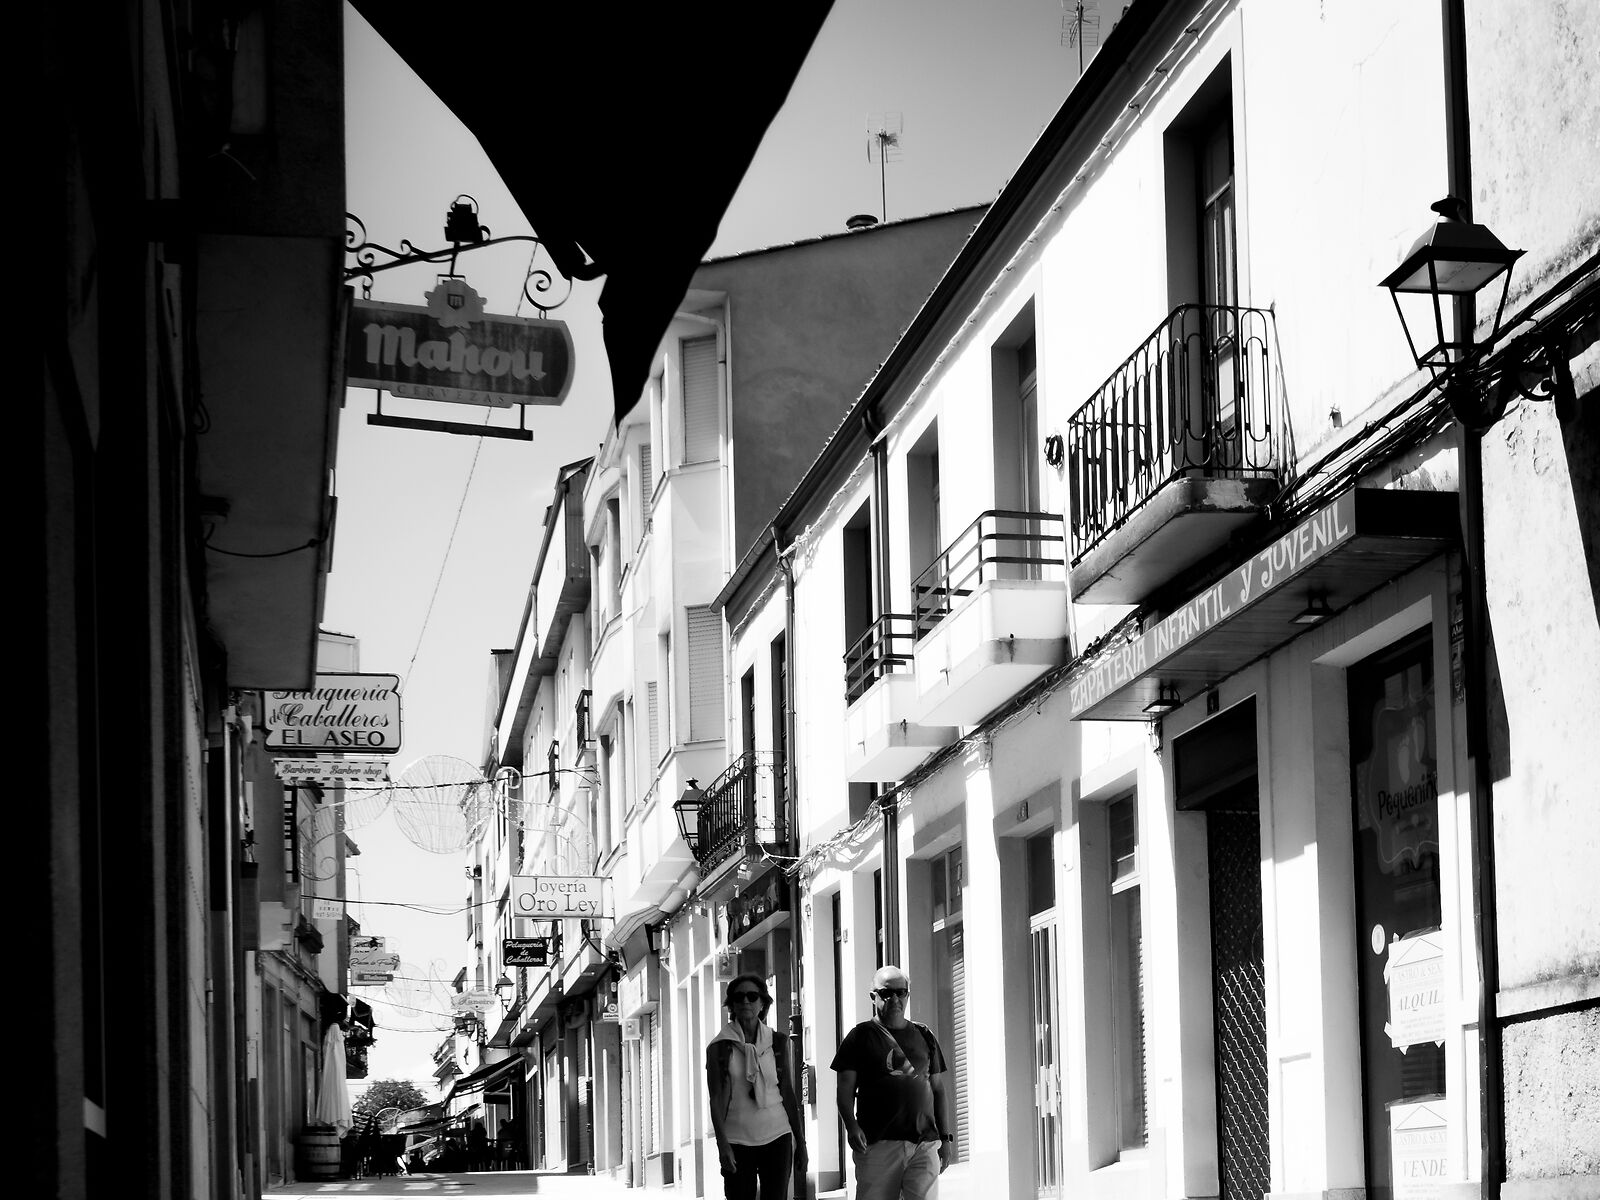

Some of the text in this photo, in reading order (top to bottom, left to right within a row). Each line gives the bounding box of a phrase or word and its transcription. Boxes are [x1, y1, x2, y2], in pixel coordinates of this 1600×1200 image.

[363, 323, 546, 381] Mahou
[397, 383, 505, 404] CERVEZAS
[1071, 637, 1147, 713] ZAPATERIA
[1153, 584, 1230, 659] INFANTIL
[1260, 501, 1348, 588] JUVENIL
[269, 703, 389, 728] de Caballeros
[282, 730, 385, 746] EL ASEO
[330, 765, 361, 775] Barber
[363, 766, 382, 778] shop
[533, 878, 587, 895] Joyería
[520, 893, 598, 916] Oro Ley
[505, 955, 543, 964] Caballeros
